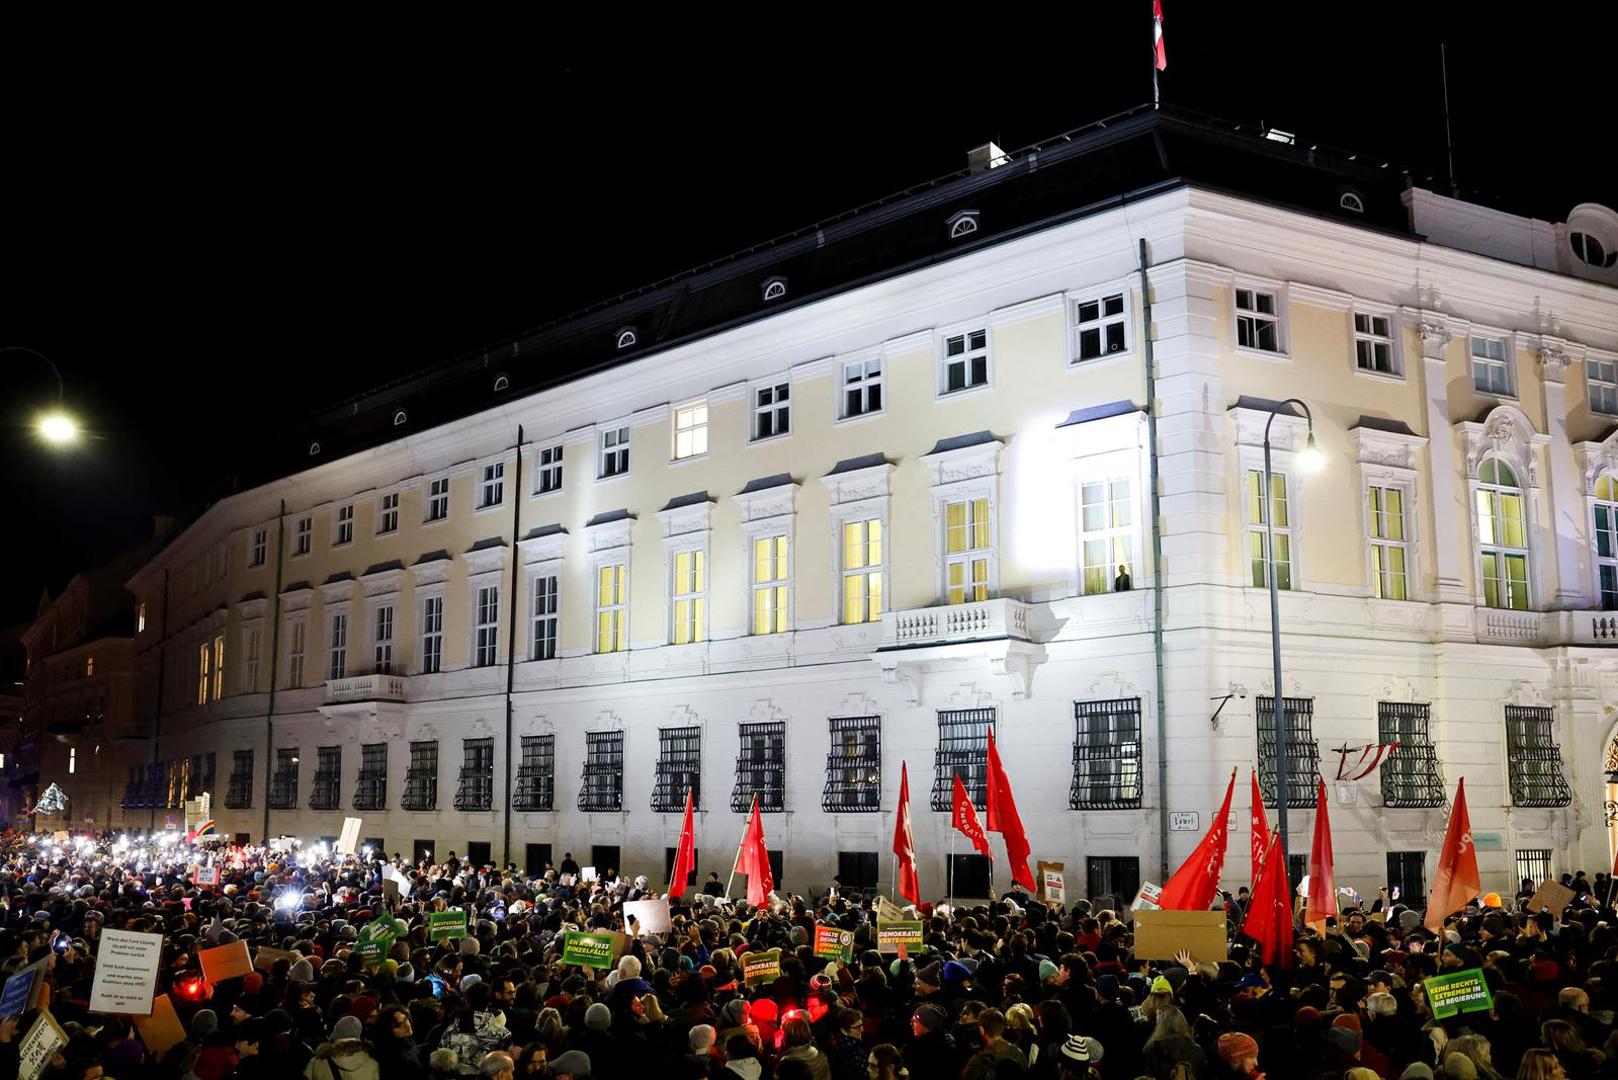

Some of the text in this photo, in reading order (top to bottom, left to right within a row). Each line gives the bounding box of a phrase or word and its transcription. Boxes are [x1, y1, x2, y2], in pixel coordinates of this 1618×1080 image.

[567, 945, 610, 956] EINZELFÄLLE
[745, 961, 778, 973] DEMOKRATIE
[745, 968, 779, 978] VERTEIDIGEN
[1430, 979, 1482, 993] KEINE RECHTS-
[1435, 987, 1472, 1000] EXTREMEN
[1435, 992, 1487, 1008] DIE REGIERUNG
